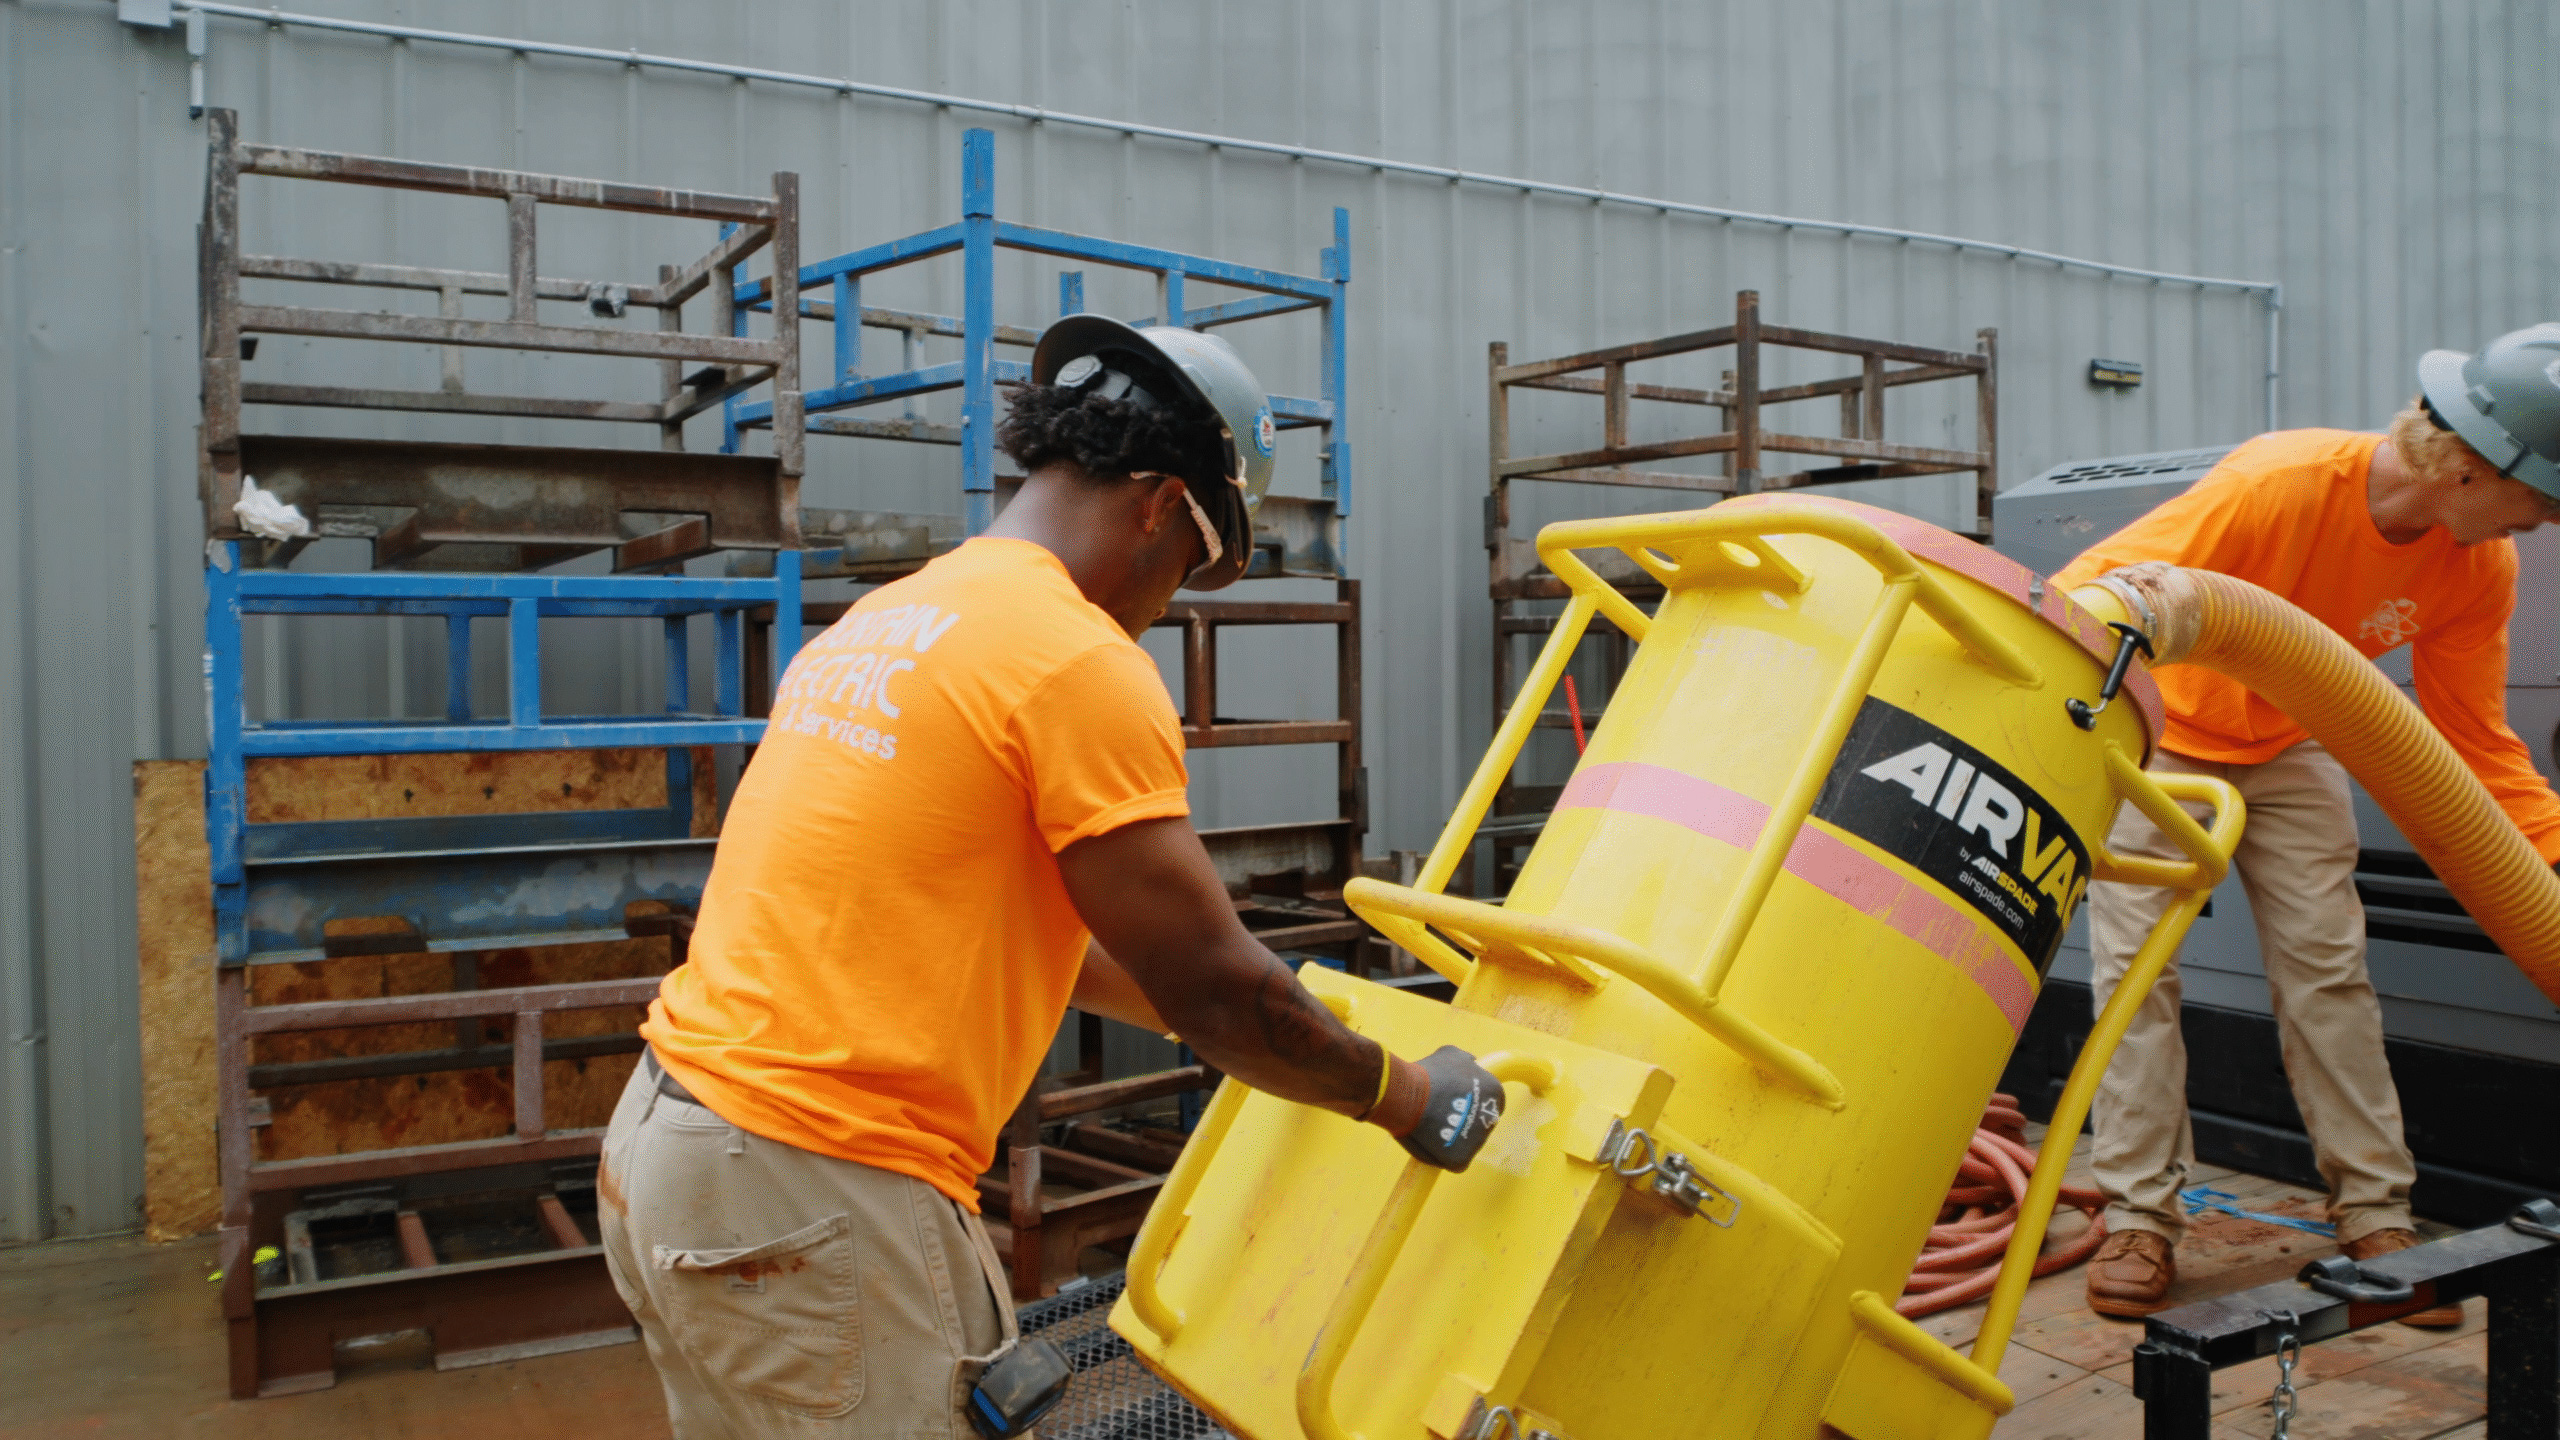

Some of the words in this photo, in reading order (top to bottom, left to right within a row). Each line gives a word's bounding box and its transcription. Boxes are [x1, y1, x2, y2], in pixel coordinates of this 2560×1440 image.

[810, 604, 961, 653] OUNTAIN
[794, 703, 898, 760] Services
[1959, 870, 2024, 930] airspade.com
[1960, 846, 1971, 862] by
[1971, 856, 2038, 917] AIRSPADE
